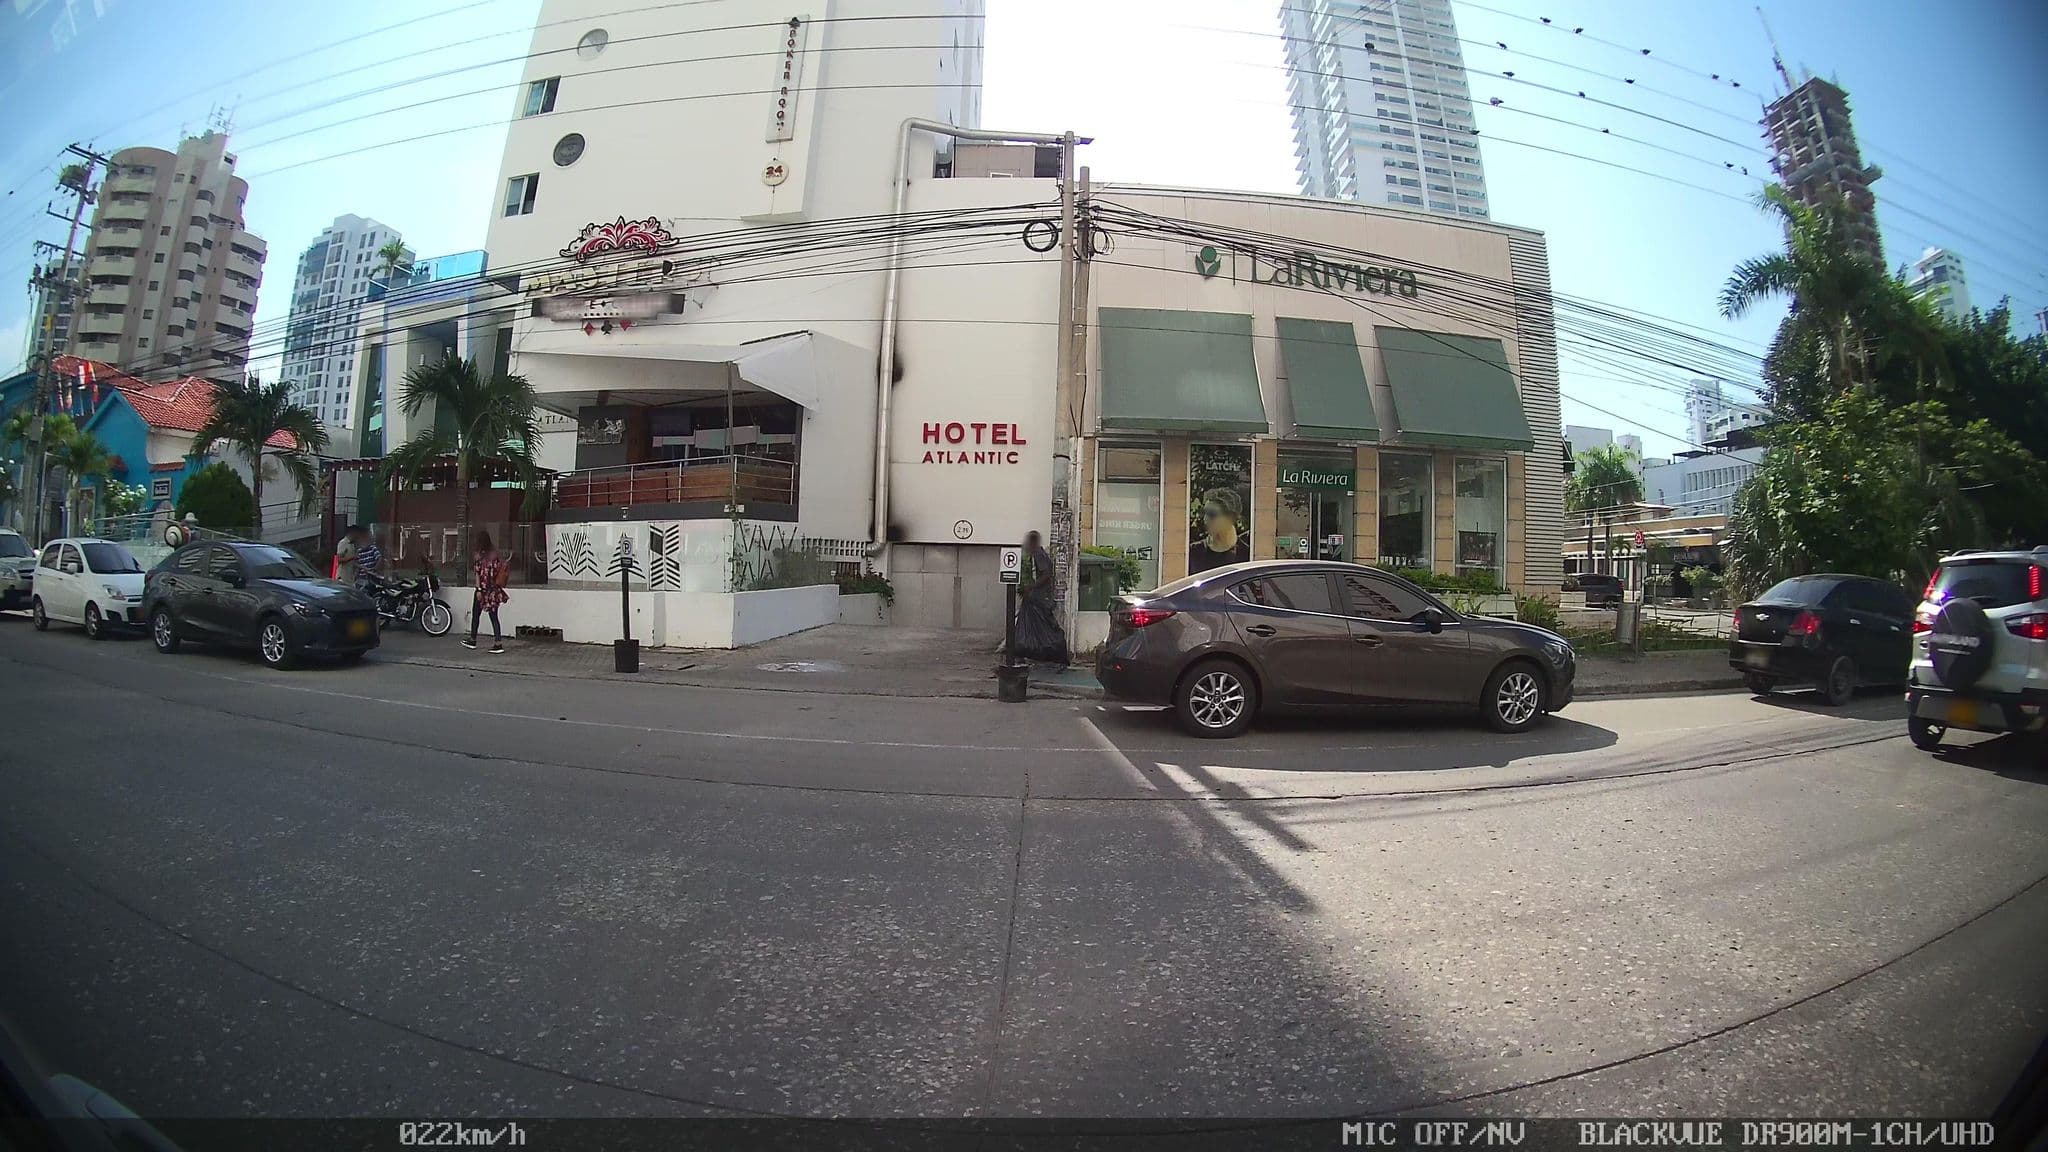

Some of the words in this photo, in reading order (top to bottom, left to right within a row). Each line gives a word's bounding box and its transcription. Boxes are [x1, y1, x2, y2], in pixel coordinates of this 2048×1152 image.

[783, 29, 798, 80] POKER
[922, 422, 1027, 445] HOTEL
[922, 451, 1019, 465] ATLANTIC
[1282, 469, 1299, 483] La
[1301, 470, 1348, 485] Riviera
